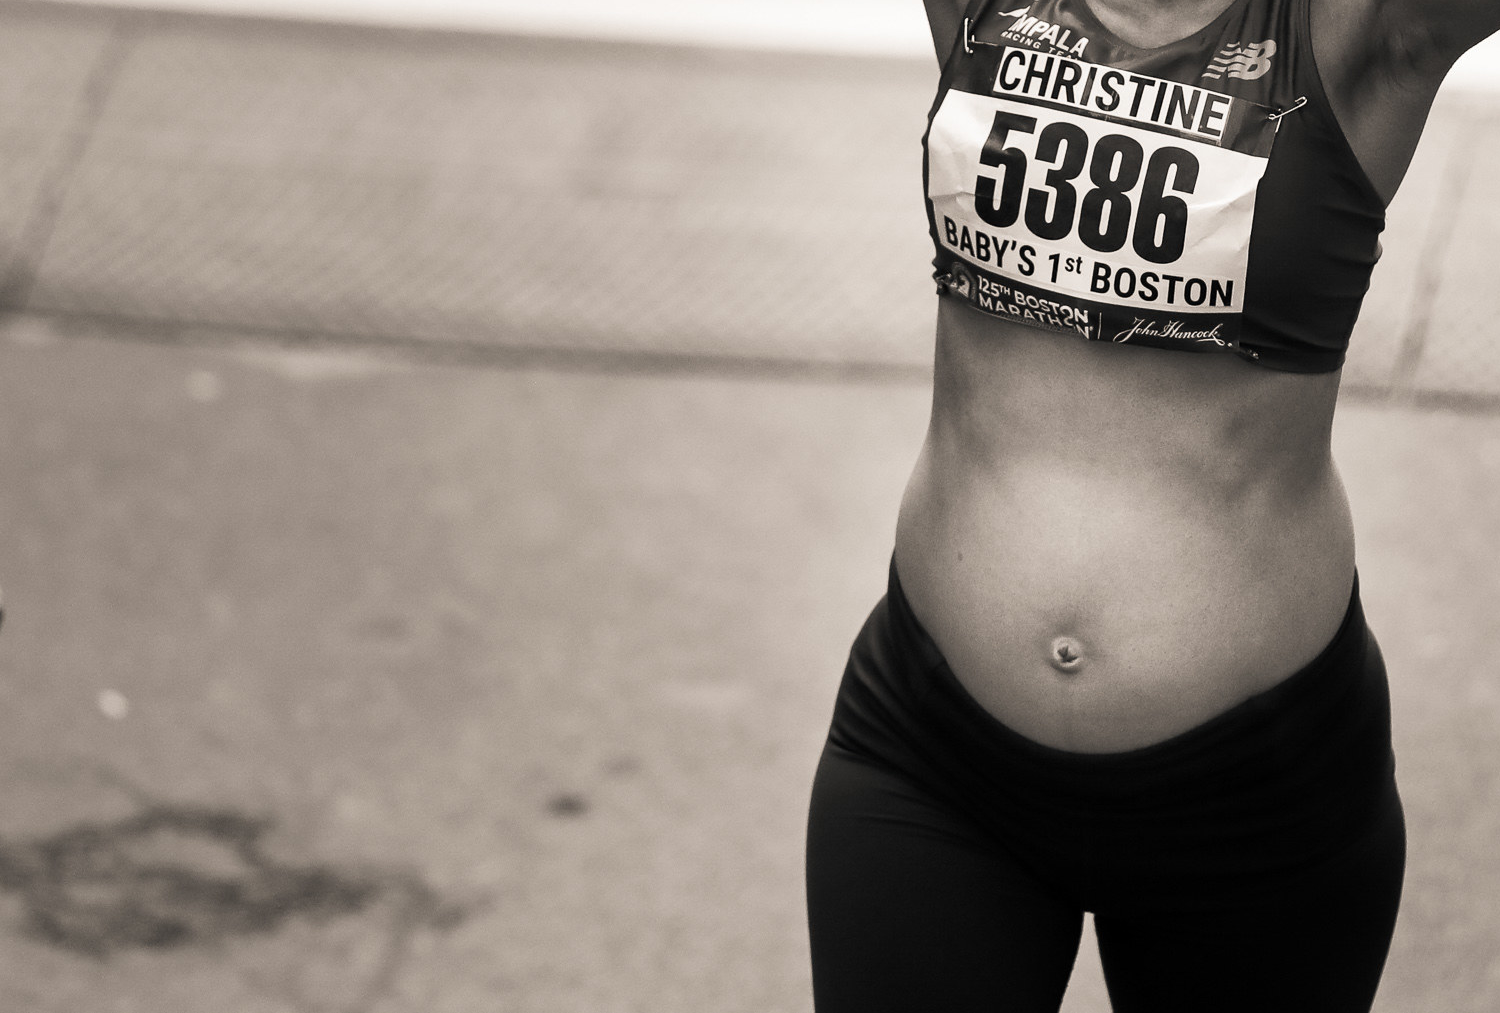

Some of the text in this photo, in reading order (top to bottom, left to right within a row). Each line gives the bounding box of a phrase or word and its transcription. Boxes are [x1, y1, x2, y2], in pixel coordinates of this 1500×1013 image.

[1000, 30, 1042, 49] RACING
[998, 50, 1231, 137] CHRISTINE
[974, 110, 1200, 265] 5386
[943, 215, 1234, 307] BABY'S 1st BOSTON
[977, 274, 1089, 324] 125TH BOSTON
[1113, 316, 1226, 347] John Hancock
